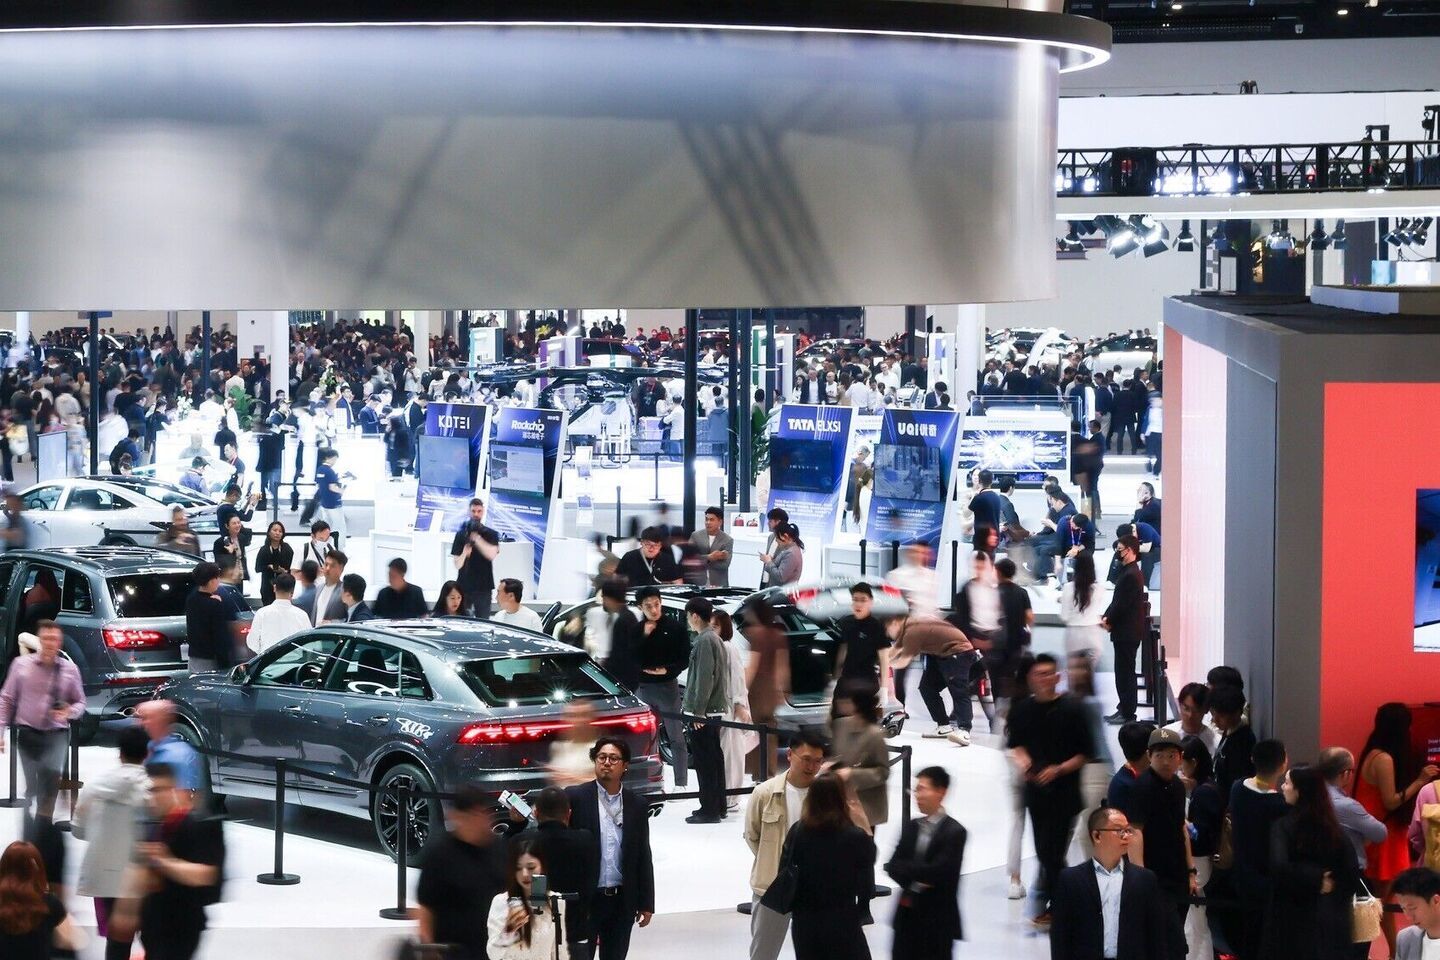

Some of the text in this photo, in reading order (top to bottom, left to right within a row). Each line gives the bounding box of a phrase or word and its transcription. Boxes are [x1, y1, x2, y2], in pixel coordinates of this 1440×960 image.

[438, 415, 471, 430] KOTEI
[511, 418, 545, 434] Rockchip
[788, 418, 841, 433] TATA ELXSI
